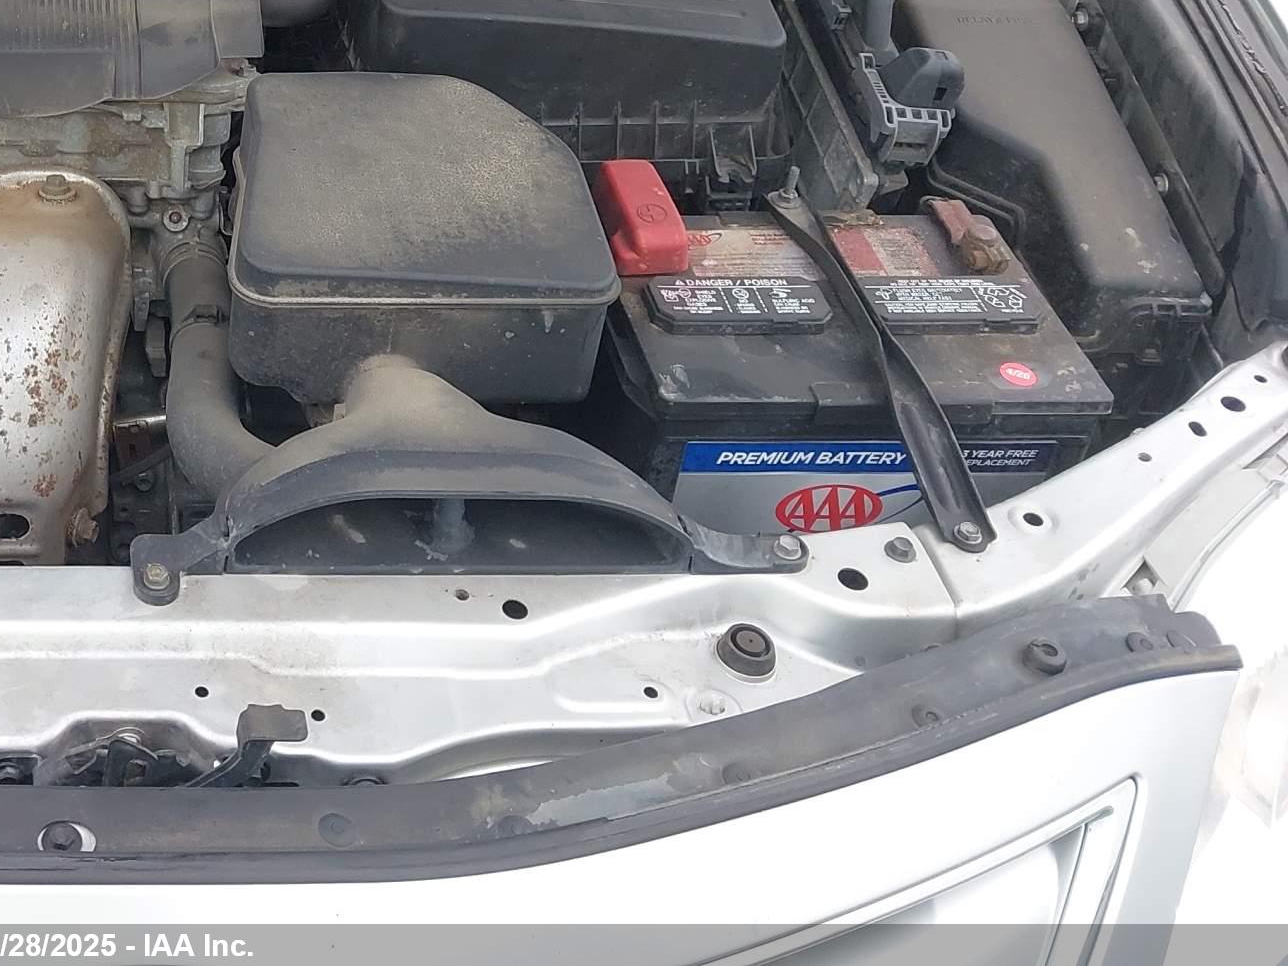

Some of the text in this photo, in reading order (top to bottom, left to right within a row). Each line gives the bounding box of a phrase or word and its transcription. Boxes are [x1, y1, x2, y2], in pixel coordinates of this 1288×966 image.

[1006, 368, 1031, 380] 4/20
[716, 450, 907, 466] PREMIUM BATTERY
[971, 449, 1005, 458] YEAR
[1005, 449, 1040, 458] FREE
[966, 458, 1033, 466] EPLACEMENT
[775, 484, 883, 532] AAA
